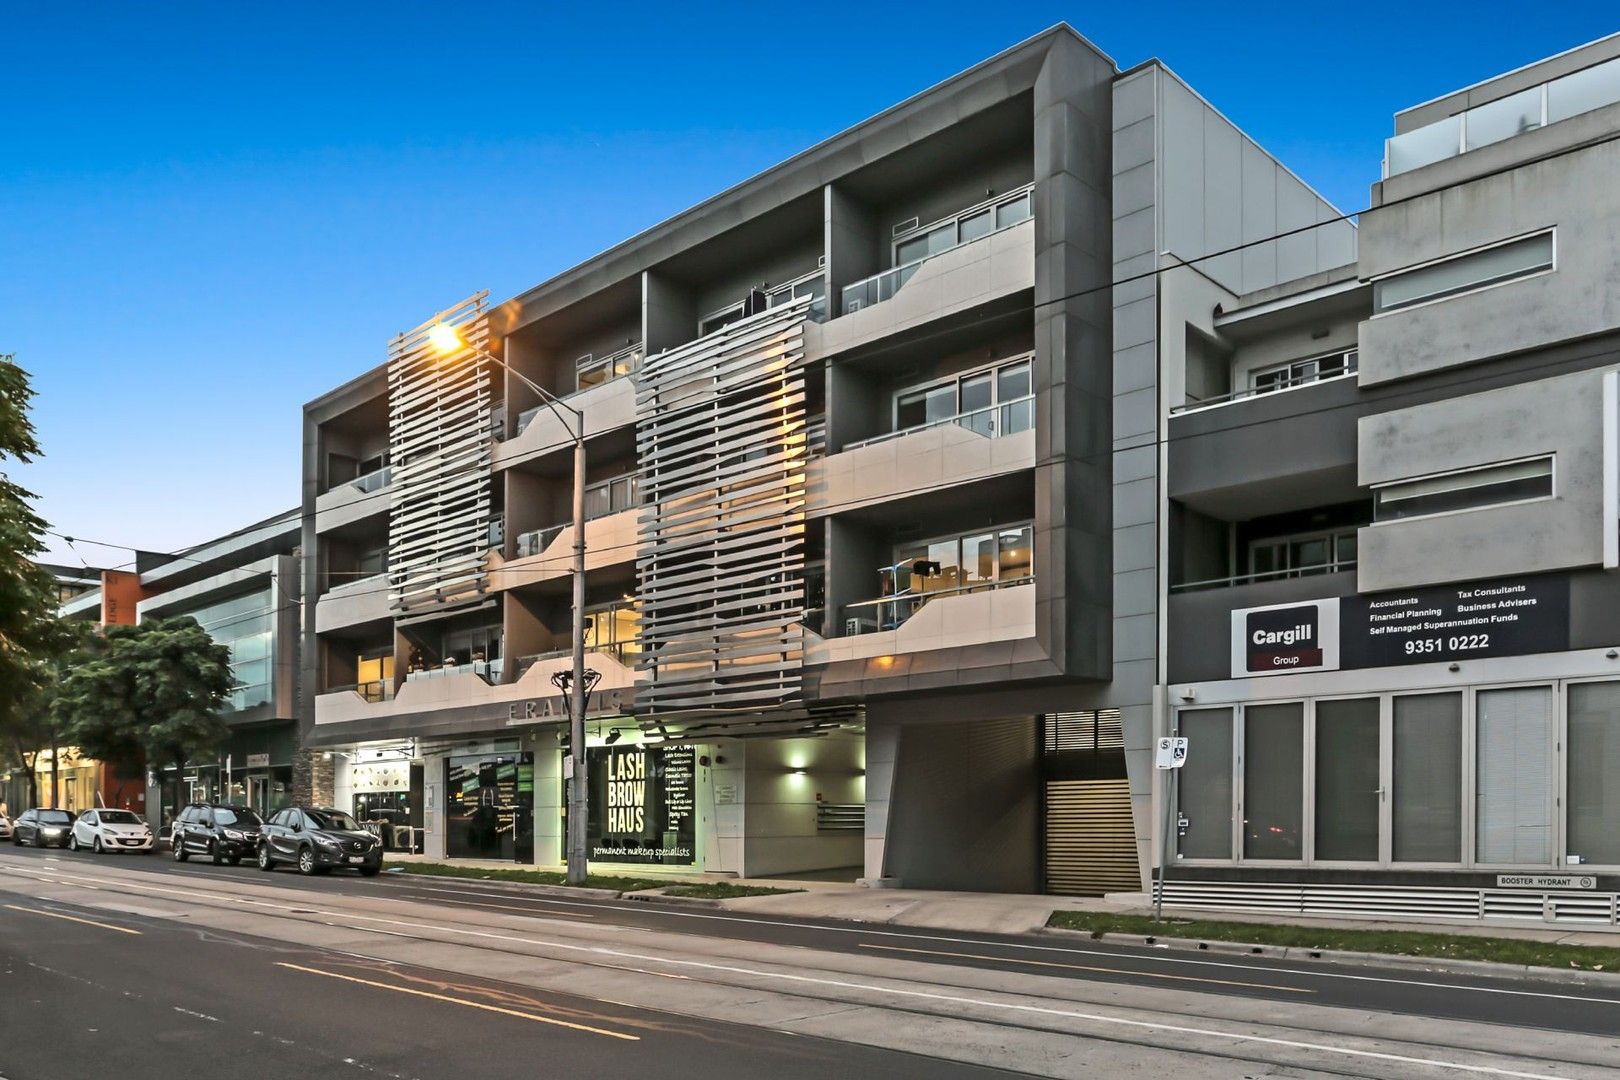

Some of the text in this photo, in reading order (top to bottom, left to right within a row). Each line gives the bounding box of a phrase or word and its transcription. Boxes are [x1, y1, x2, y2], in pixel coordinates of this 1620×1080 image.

[1457, 585, 1526, 599] Tax Consultants
[1369, 597, 1419, 608] Accountants
[1457, 598, 1537, 613] Business Advisers
[1369, 608, 1442, 622] Financial Planning
[1369, 613, 1519, 635] Self Managed Superannuation Funds
[1252, 624, 1312, 645] Cargill
[1405, 634, 1489, 655] 9351 0222
[1273, 656, 1300, 666] Group
[508, 691, 624, 721] FRANIS
[608, 752, 645, 781] LASH
[608, 780, 646, 807] BROW
[608, 807, 645, 833] HAUS
[593, 845, 690, 860] permanent makeup specialists
[1501, 877, 1534, 885] BOOSTER
[1537, 878, 1572, 886] HYDRANT
